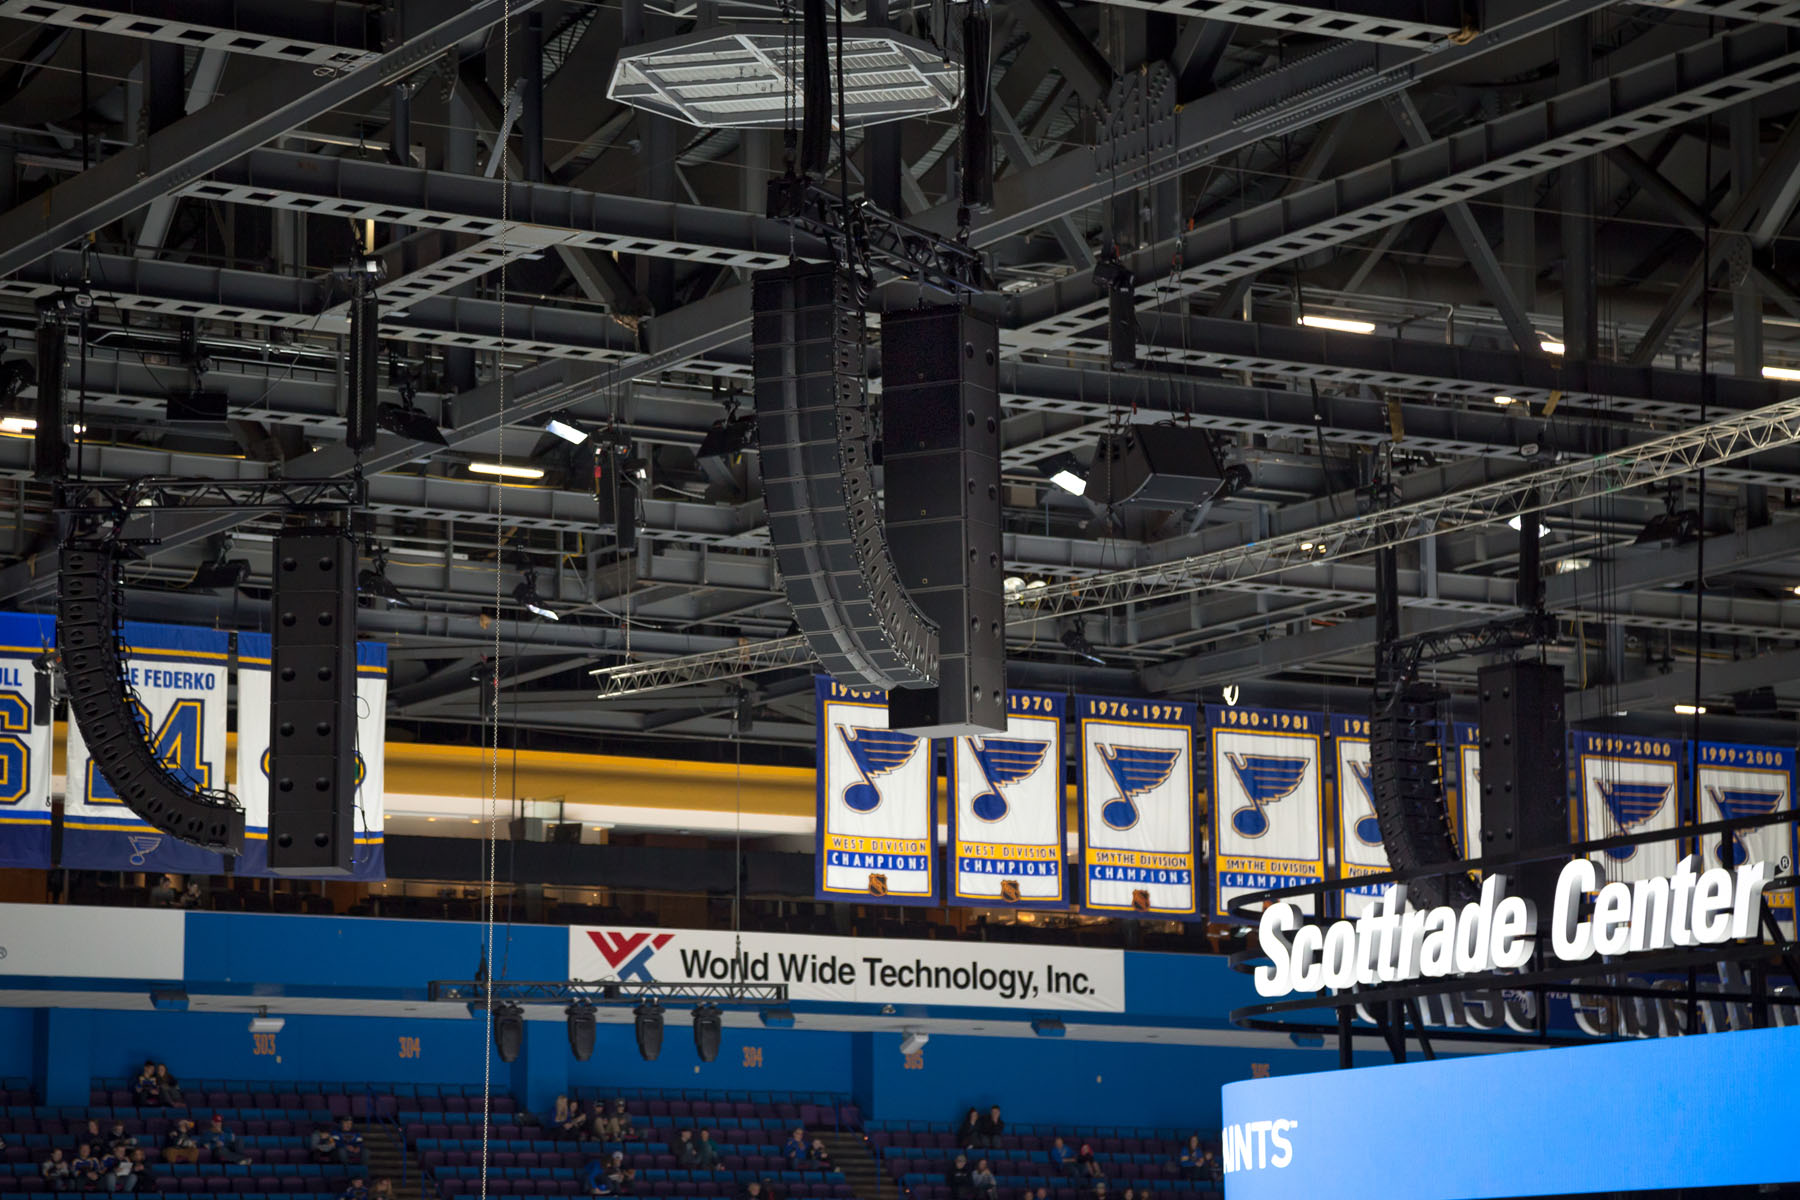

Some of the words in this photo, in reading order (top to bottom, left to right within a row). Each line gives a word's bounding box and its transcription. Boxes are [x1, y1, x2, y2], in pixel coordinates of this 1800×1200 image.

[144, 669, 215, 690] FEDERKO
[832, 837, 864, 850] WEST
[872, 840, 926, 853] DIVISION
[963, 844, 995, 856] WEST
[1003, 847, 1056, 859] DIVISION
[832, 852, 926, 870] CHAMPIONS
[963, 859, 1056, 875] CHAMPIONS
[1096, 852, 1136, 865] SMYTHE
[1140, 855, 1187, 867] DIVISION
[1226, 859, 1266, 872] SMYTHE
[1270, 861, 1316, 874] DIVISION
[1095, 867, 1189, 883] CHAMPIONS
[1254, 873, 1537, 998] Scottrade
[680, 949, 769, 981] World
[778, 952, 856, 985] Wide
[862, 957, 1039, 1000] Technology,
[1047, 965, 1096, 995] Inc.
[253, 1033, 276, 1055] 303
[399, 1037, 421, 1058] 304
[742, 1046, 763, 1067] 304
